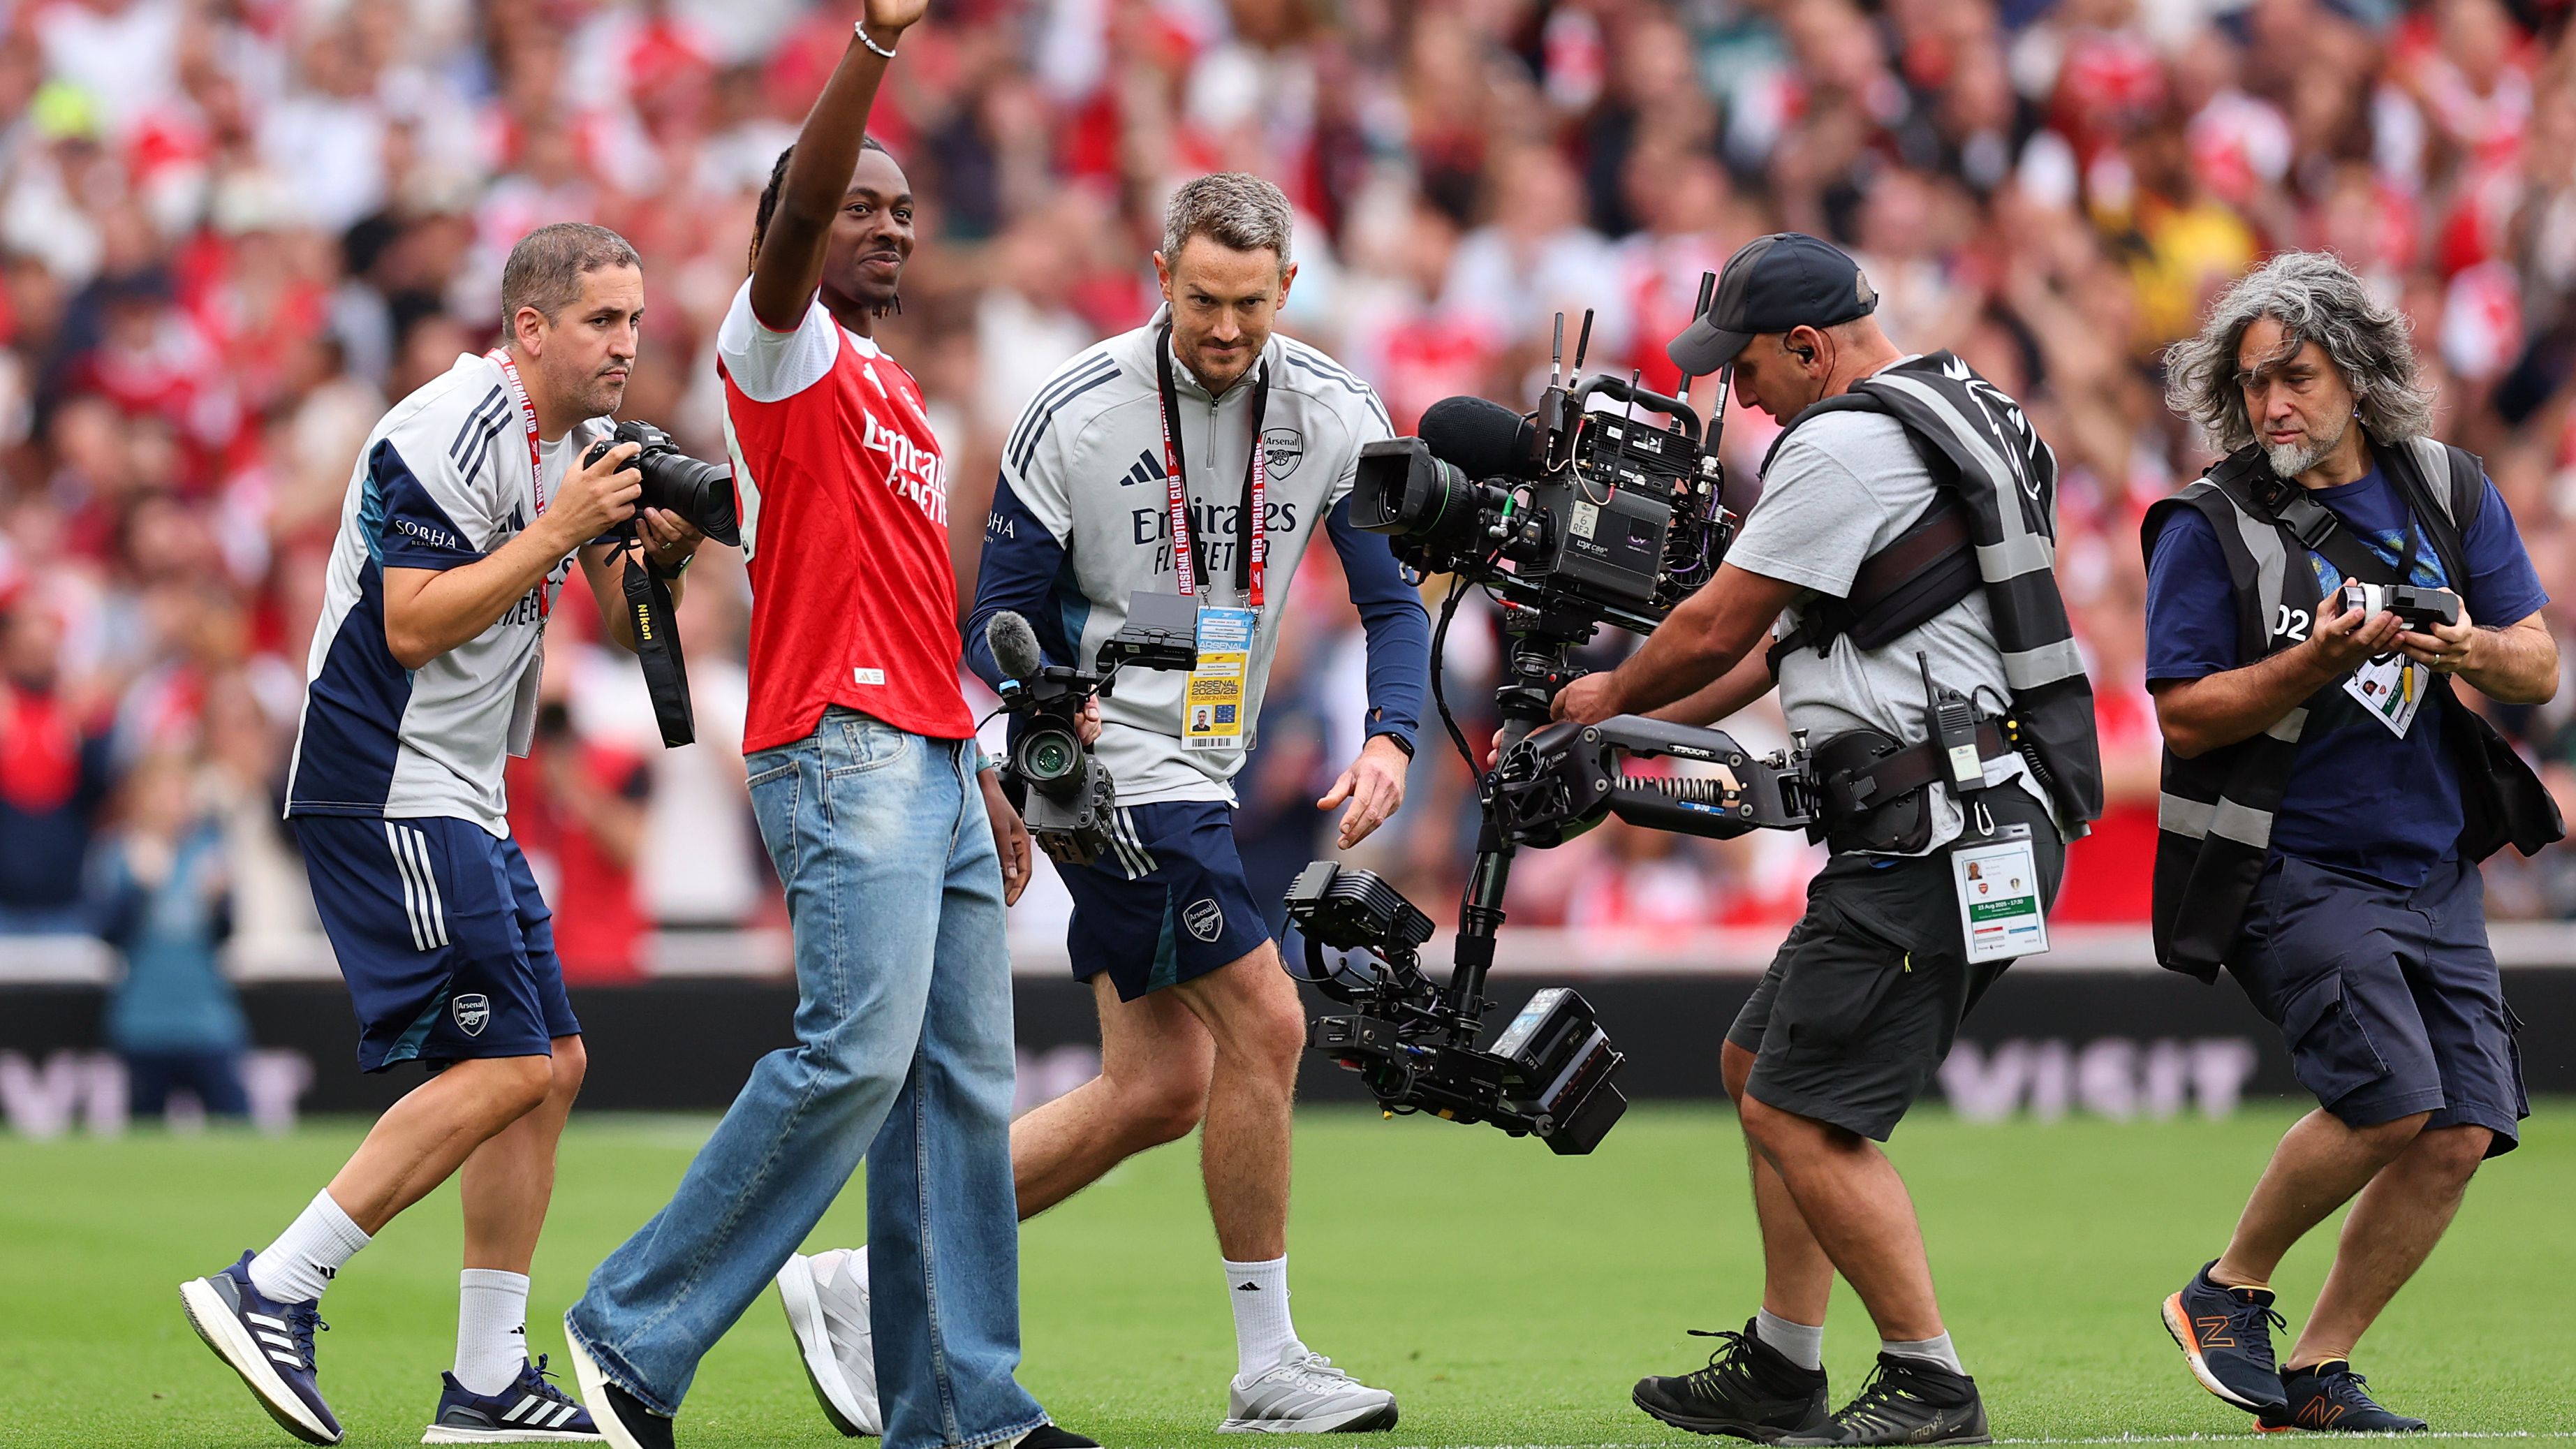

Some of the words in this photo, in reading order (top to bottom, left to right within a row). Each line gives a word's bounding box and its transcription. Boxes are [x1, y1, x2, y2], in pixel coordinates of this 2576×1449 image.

[503, 364, 531, 409] FOOTBALL
[523, 409, 537, 434] CLUB
[862, 407, 947, 495] Emirat
[1265, 436, 1297, 446] Arsenal
[1253, 443, 1263, 486] ARSENAL
[533, 463, 545, 506] ARSENAL
[1169, 475, 1182, 500] CLUB
[1131, 496, 1297, 545] Eiraes
[1171, 501, 1188, 549] FOOTBALL
[1252, 488, 1264, 536] FOOTBALL
[1580, 515, 1587, 525] 6
[395, 520, 456, 549] SOBHA
[1251, 538, 1263, 563] CLUB
[1154, 543, 1177, 575] FL
[1177, 550, 1193, 594] ARSENAL
[638, 604, 652, 640] Nikon
[1192, 679, 1239, 688] ARSENAL
[1192, 687, 1239, 696] 2025/26
[1190, 905, 1214, 921] Arsenal
[458, 1000, 485, 1010] Arsenal
